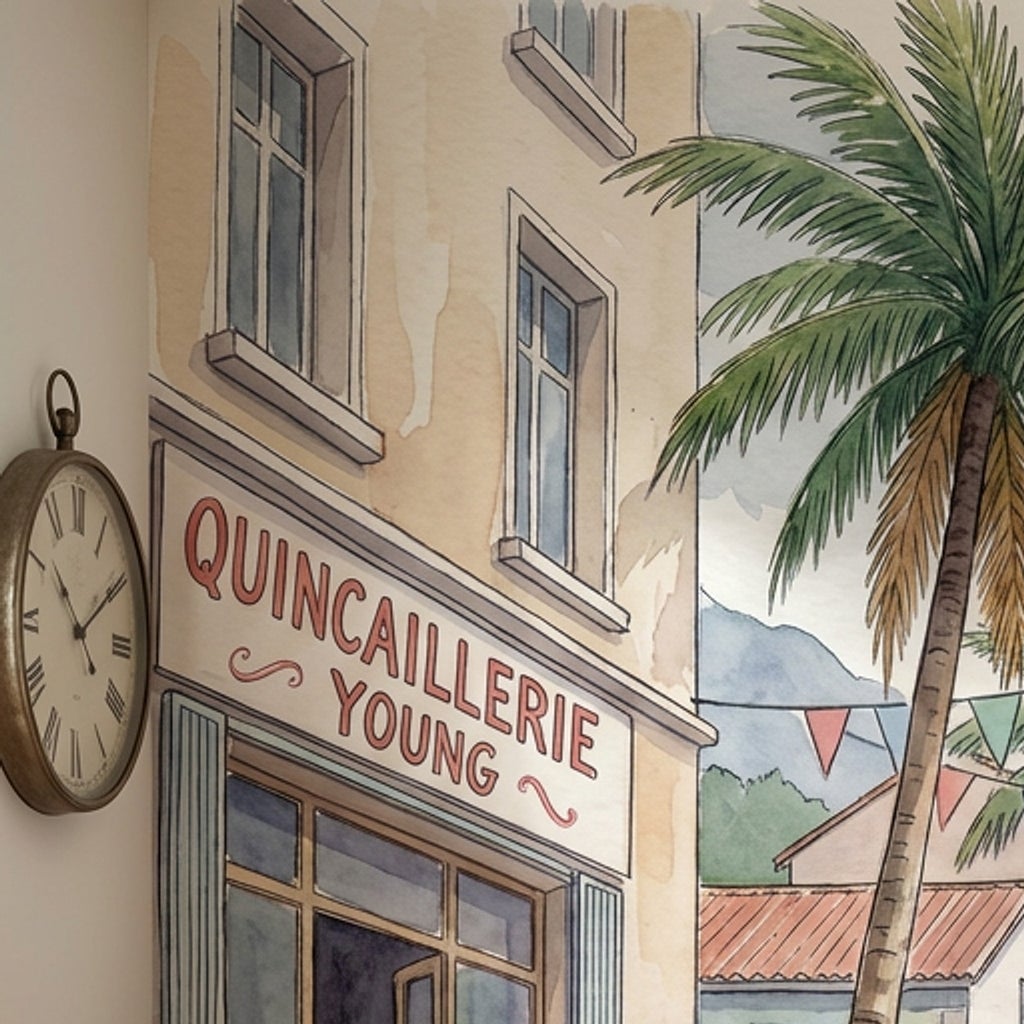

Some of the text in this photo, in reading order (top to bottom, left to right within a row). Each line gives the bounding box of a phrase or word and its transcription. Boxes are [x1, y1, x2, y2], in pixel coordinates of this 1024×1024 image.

[111, 632, 131, 660] III
[184, 497, 599, 779] QUINCAILLERIE
[330, 668, 499, 796] YOUNG
